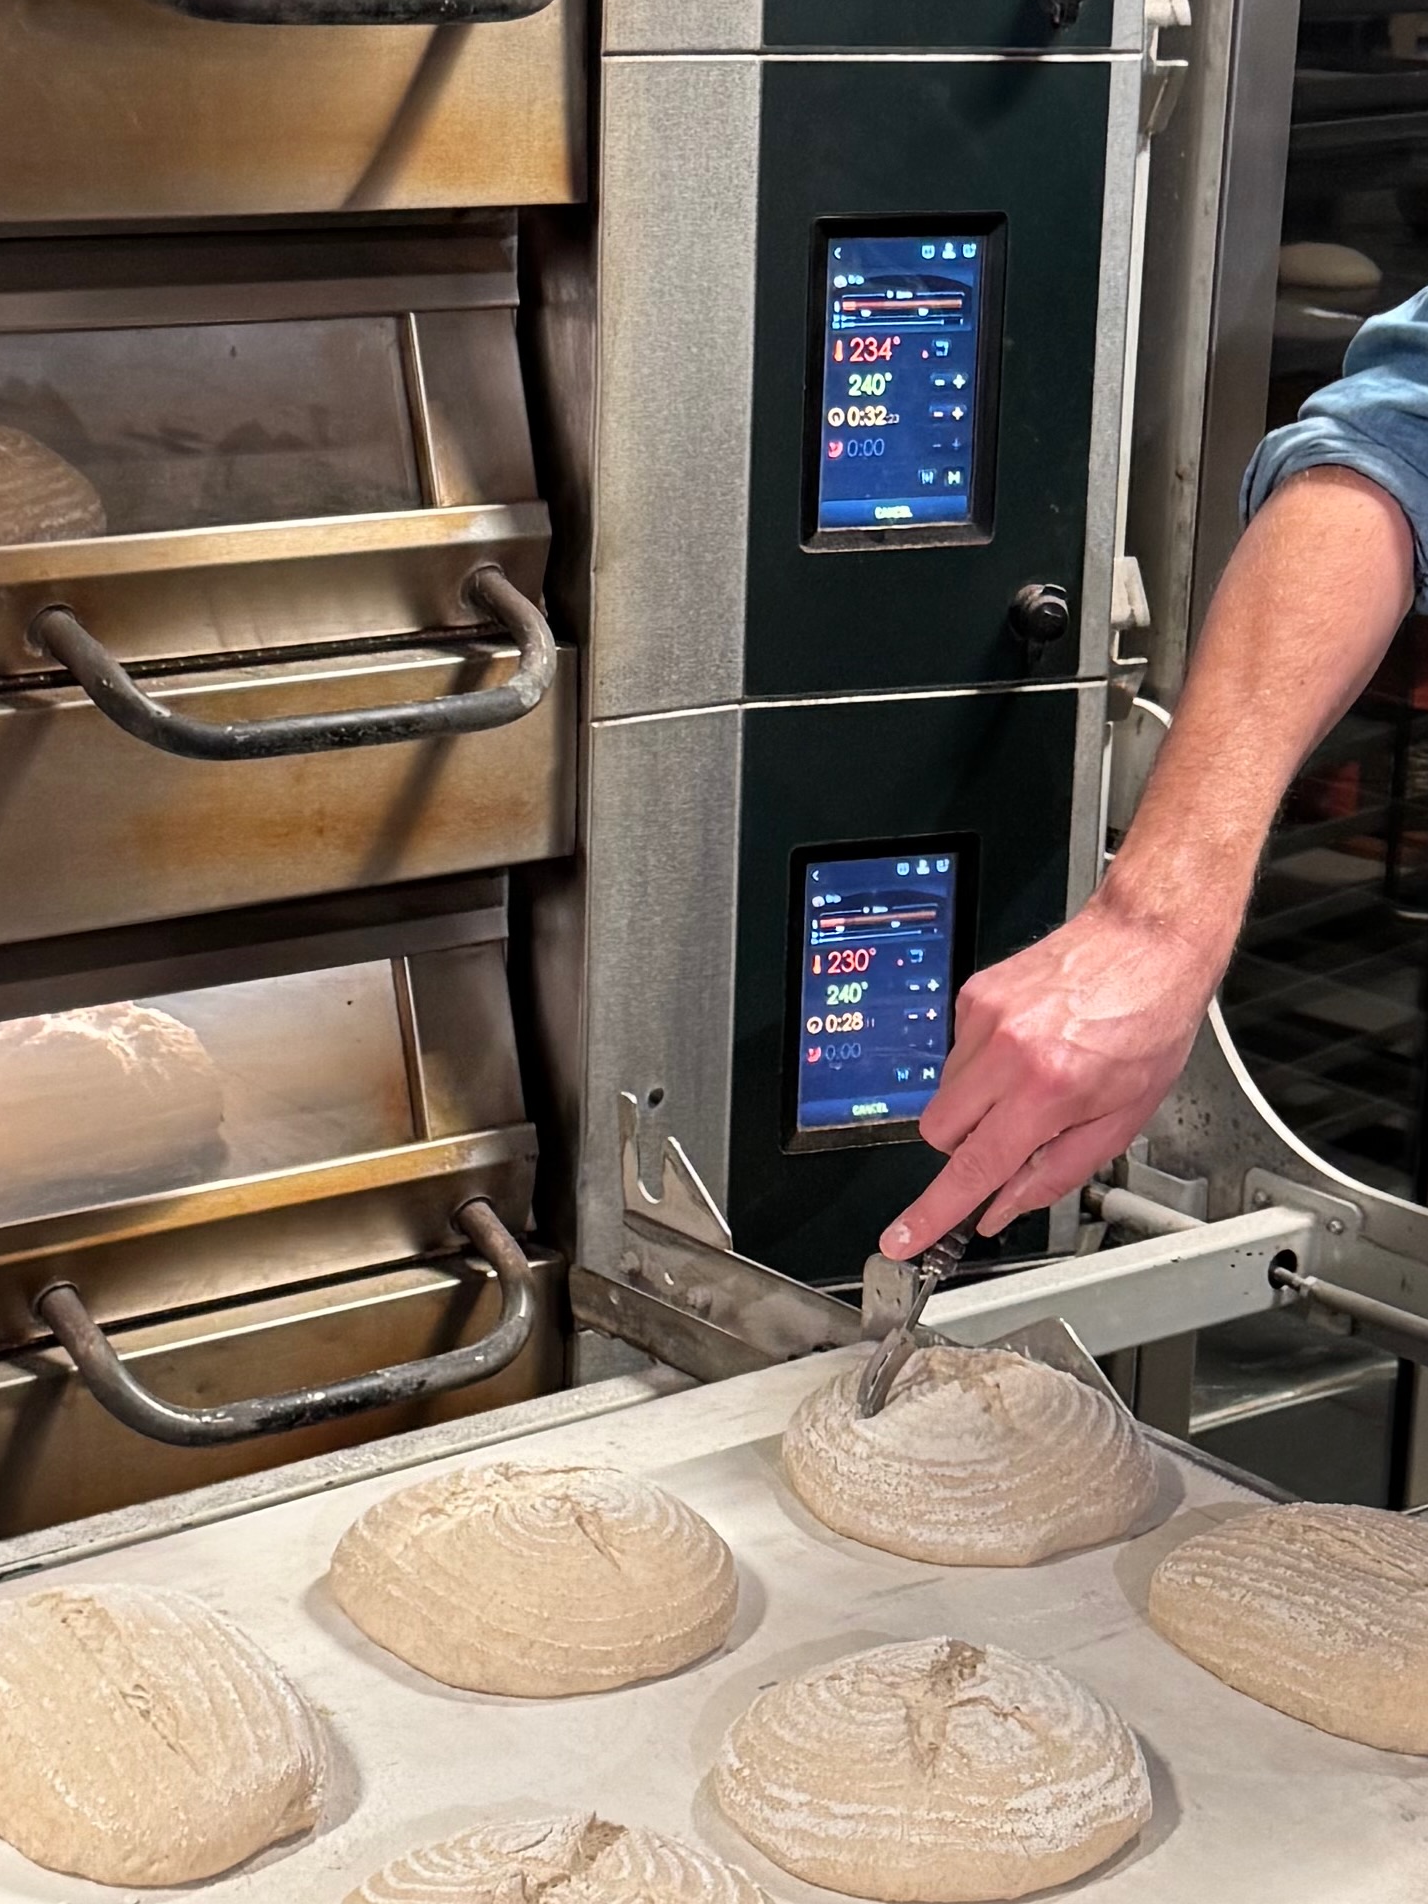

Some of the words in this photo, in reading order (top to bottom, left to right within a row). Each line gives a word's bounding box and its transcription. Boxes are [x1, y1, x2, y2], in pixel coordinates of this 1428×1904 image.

[847, 405, 887, 427] 0:32
[847, 438, 885, 457] 0:00
[825, 1011, 863, 1033] 0:28
